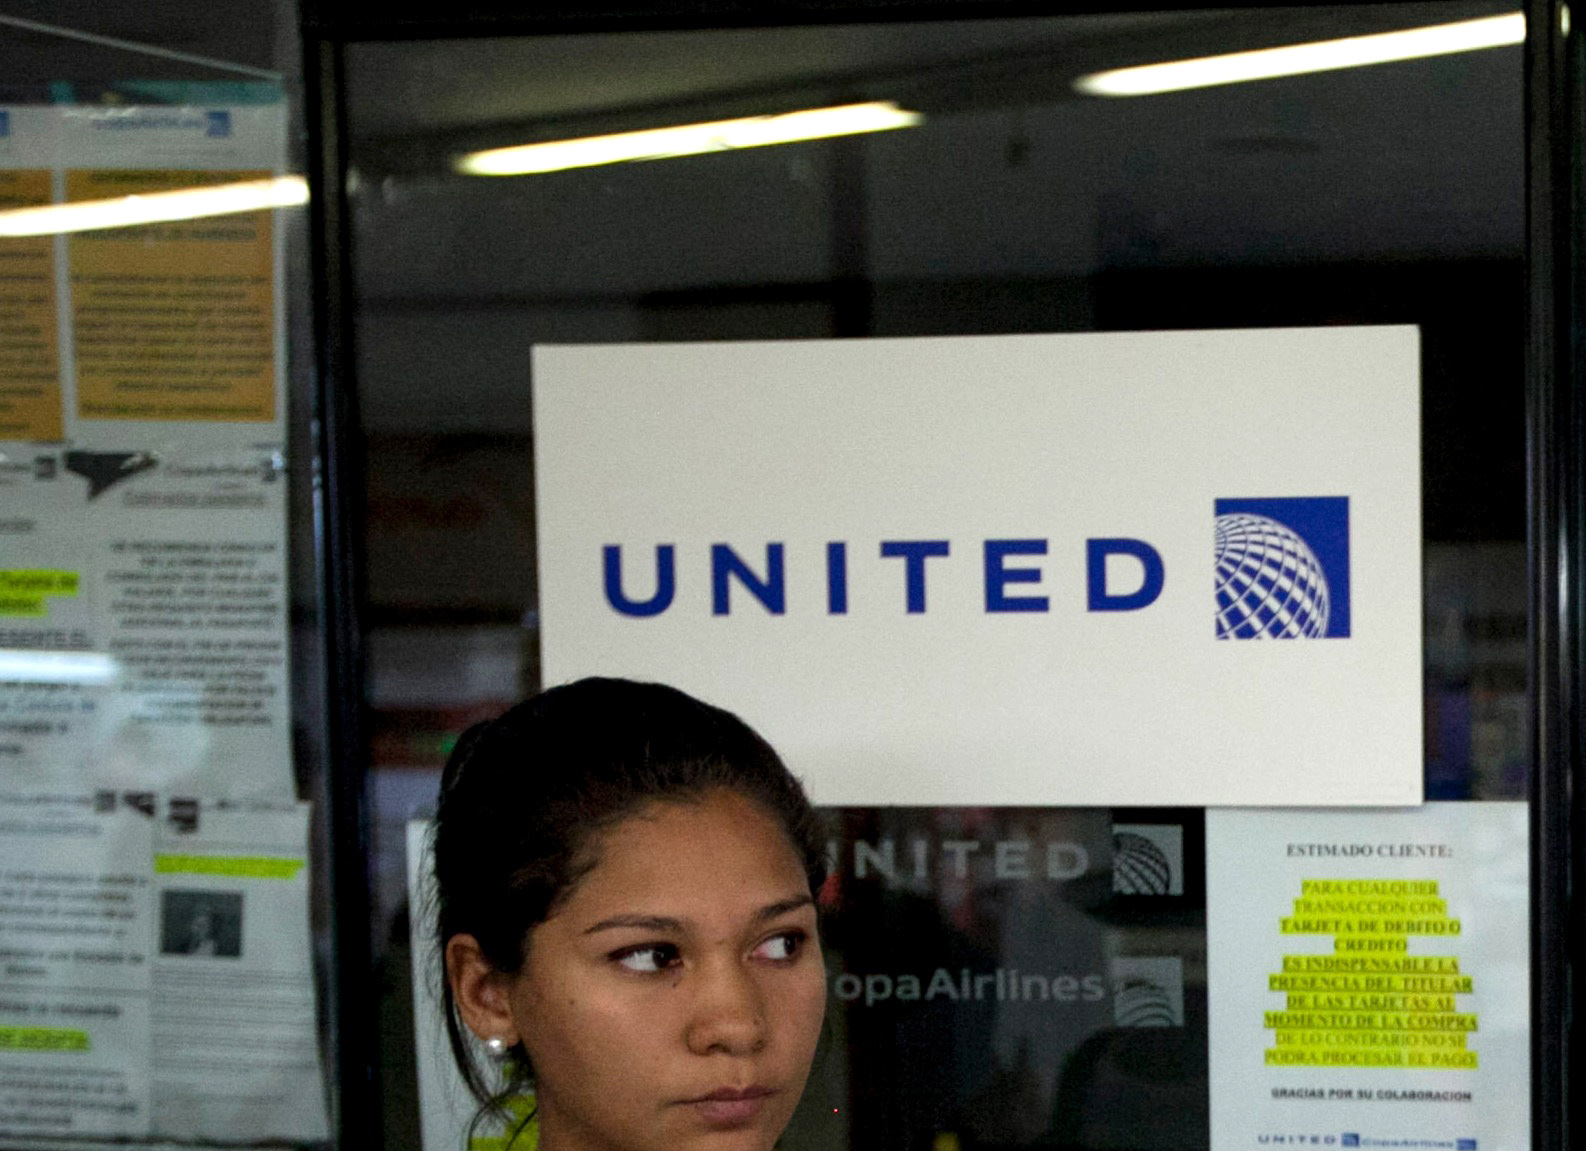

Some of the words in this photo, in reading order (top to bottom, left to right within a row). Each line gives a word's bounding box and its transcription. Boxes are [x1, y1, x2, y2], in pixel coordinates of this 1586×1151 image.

[602, 537, 1166, 619] UNITED
[1286, 844, 1373, 858] ESTIMADO
[1301, 881, 1342, 895] PARA
[1346, 881, 1439, 897] CUALQUIER
[1408, 900, 1444, 914] CON
[1280, 919, 1353, 933] TARJETA
[1358, 919, 1380, 933] DE
[1384, 919, 1446, 933] DEBITO
[1449, 920, 1461, 933] O
[1334, 938, 1408, 952] CREDITO
[1283, 957, 1302, 972] ES
[1306, 957, 1431, 973] INDISPENSABLE
[1437, 959, 1459, 973] LA
[833, 967, 1106, 1007] opaAirlines
[1269, 976, 1361, 990] PRESENCIA
[1365, 976, 1395, 991] DEL
[1403, 978, 1473, 992] TITULAR
[1287, 994, 1308, 1008] DE
[1312, 994, 1345, 1009] LAS
[1349, 995, 1428, 1010] TARJETAS
[1434, 996, 1455, 1010] AL
[1264, 1013, 1351, 1028] MOMENTO
[1356, 1014, 1376, 1028] DE
[1381, 1014, 1403, 1029] LA
[1407, 1014, 1477, 1030] COMPRA
[1276, 1032, 1297, 1046] DE
[1301, 1032, 1322, 1046] LO
[1325, 1032, 1419, 1048] CONTRARIO
[1422, 1033, 1446, 1048] NO
[1448, 1034, 1466, 1048] SE
[1321, 1051, 1402, 1066] PROCESAR
[1408, 1052, 1427, 1066] EL
[1271, 1088, 1325, 1099] GRACIAS
[1328, 1089, 1353, 1099] POR
[1357, 1089, 1373, 1100] SU
[1376, 1089, 1473, 1101] COLABORACION
[1257, 1134, 1336, 1145] UNITED
